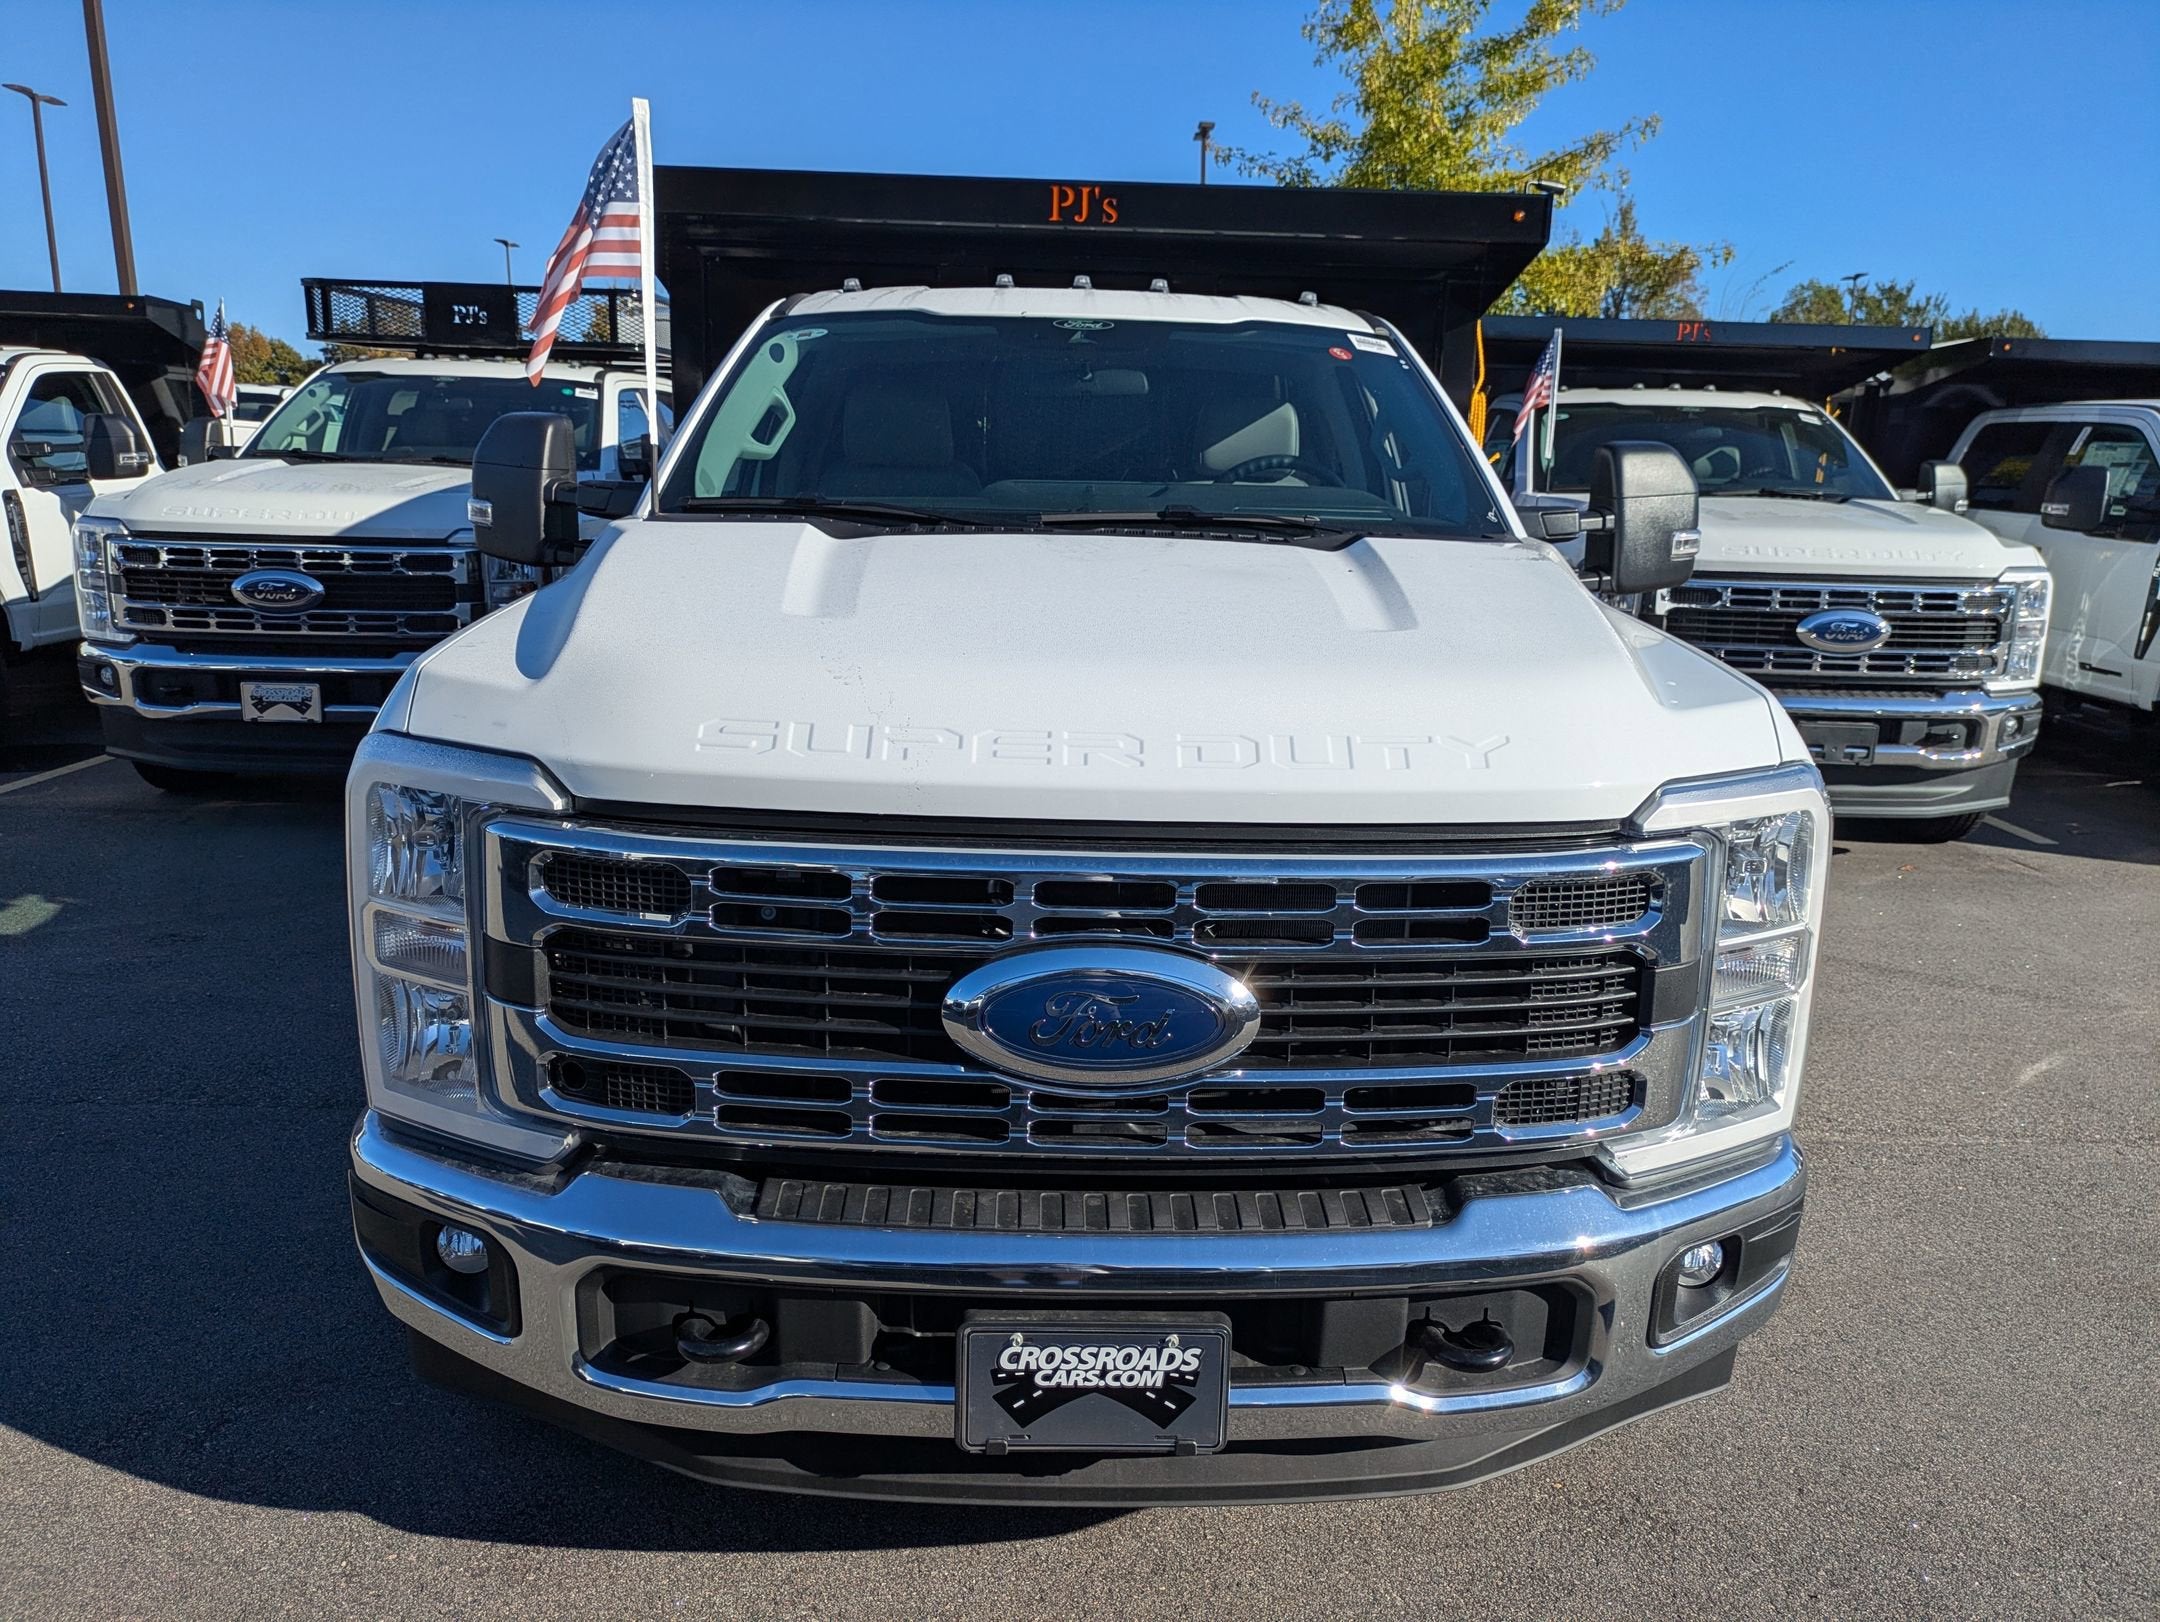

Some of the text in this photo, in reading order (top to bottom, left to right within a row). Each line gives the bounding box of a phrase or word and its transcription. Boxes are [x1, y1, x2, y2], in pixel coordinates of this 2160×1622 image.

[1049, 184, 1119, 224] PJ's
[452, 305, 488, 325] PJ's
[1063, 320, 1103, 329] Ford
[692, 716, 1513, 771] SUPER DUTY
[1029, 990, 1175, 1048] Ford
[1000, 1346, 1202, 1371] CROSSROADS
[1034, 1369, 1164, 1388] CARS.COM
